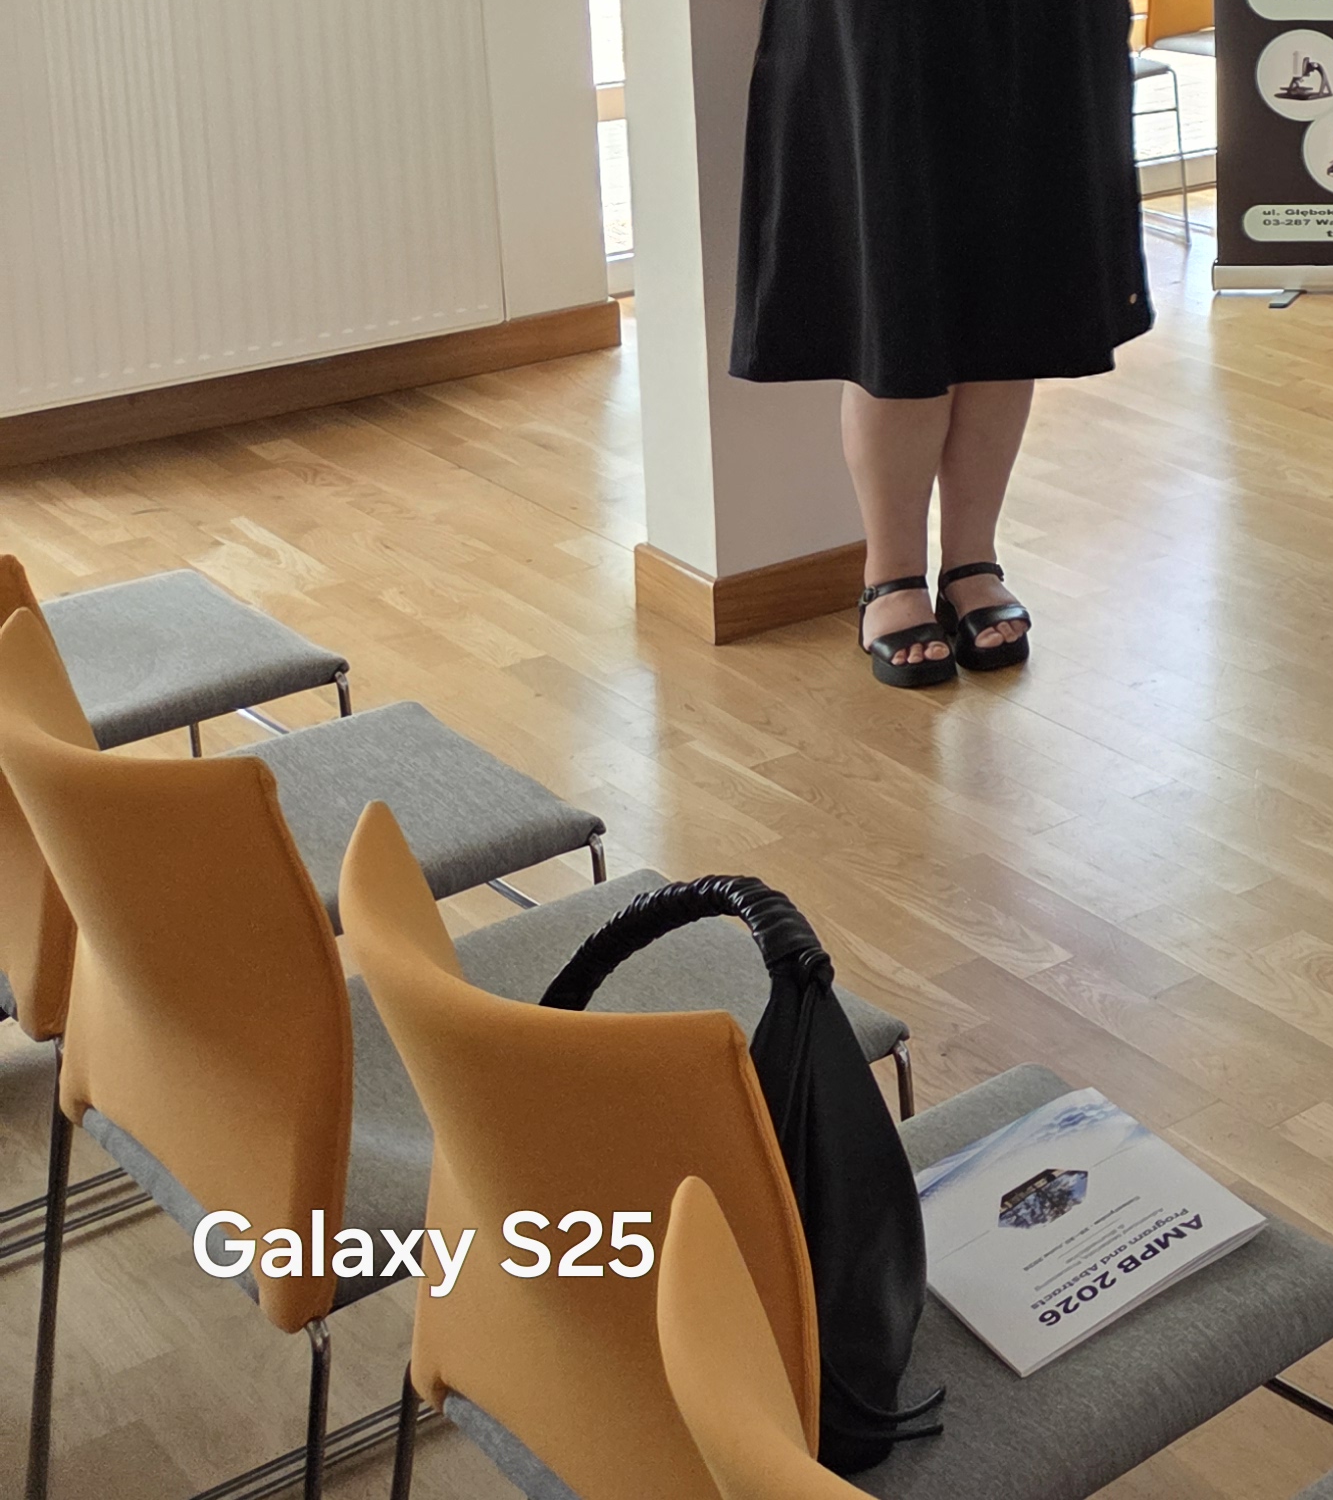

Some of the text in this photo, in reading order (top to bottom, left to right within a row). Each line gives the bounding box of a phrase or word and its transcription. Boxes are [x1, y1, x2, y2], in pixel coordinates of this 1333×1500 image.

[1262, 218, 1311, 226] 03-287
[1116, 1213, 1203, 1274] AMPB
[1128, 1207, 1190, 1246] Program
[1099, 1244, 1128, 1266] and
[1030, 1262, 1100, 1311] Abstracts
[1037, 1270, 1117, 1327] 2026
